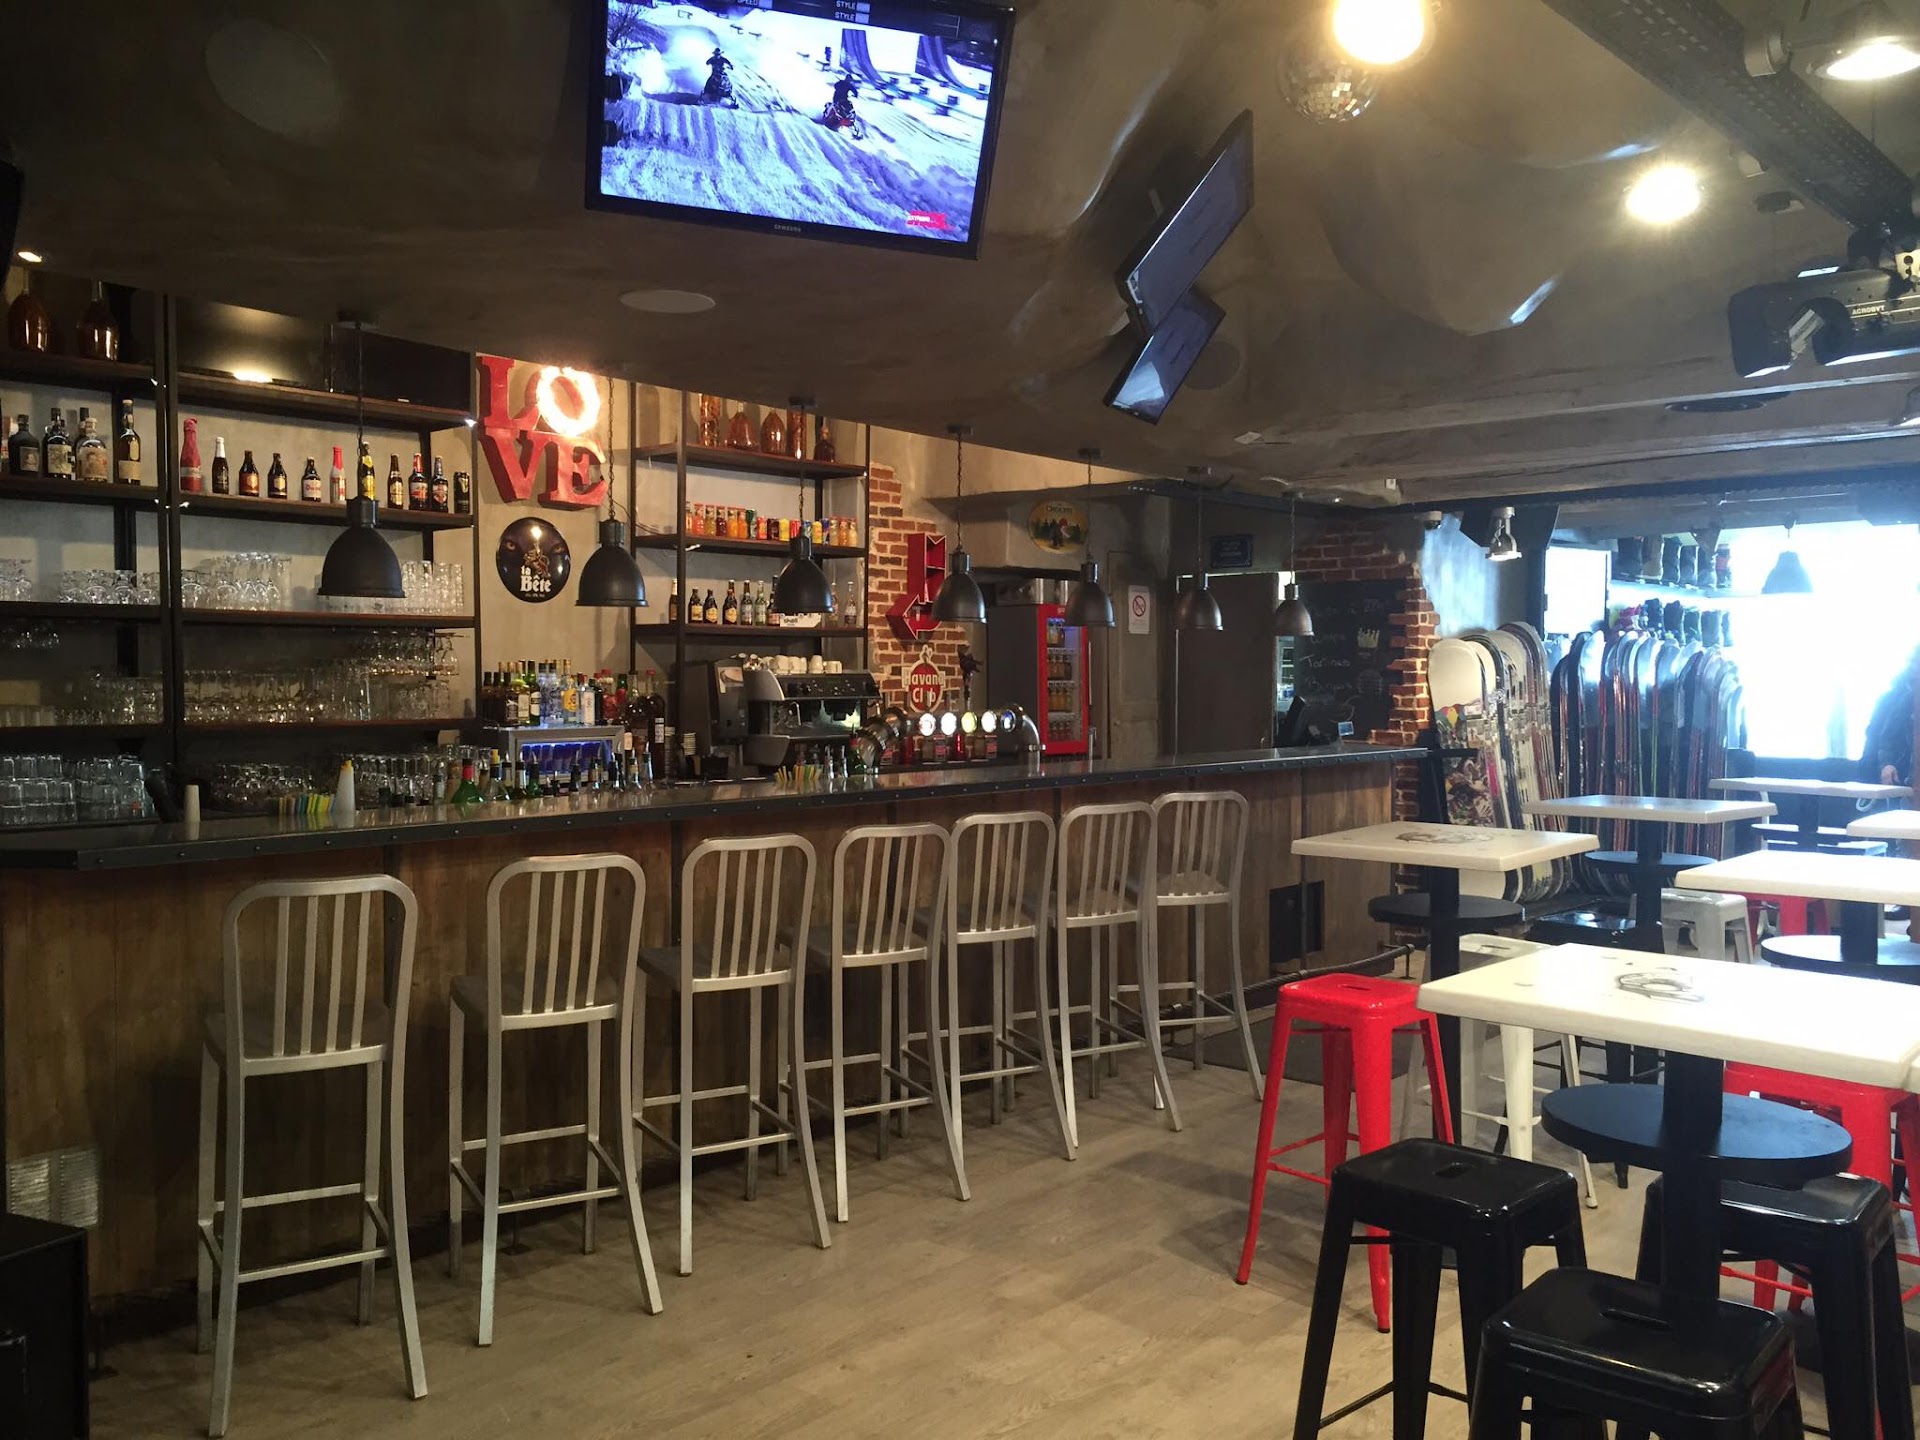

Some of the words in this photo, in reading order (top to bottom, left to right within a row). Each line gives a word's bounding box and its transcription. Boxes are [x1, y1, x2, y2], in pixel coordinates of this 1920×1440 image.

[836, 1, 856, 10] STYLE
[835, 12, 855, 21] STYLE
[520, 574, 552, 593] Bête
[902, 669, 945, 686] Havana
[912, 687, 937, 703] Clb
